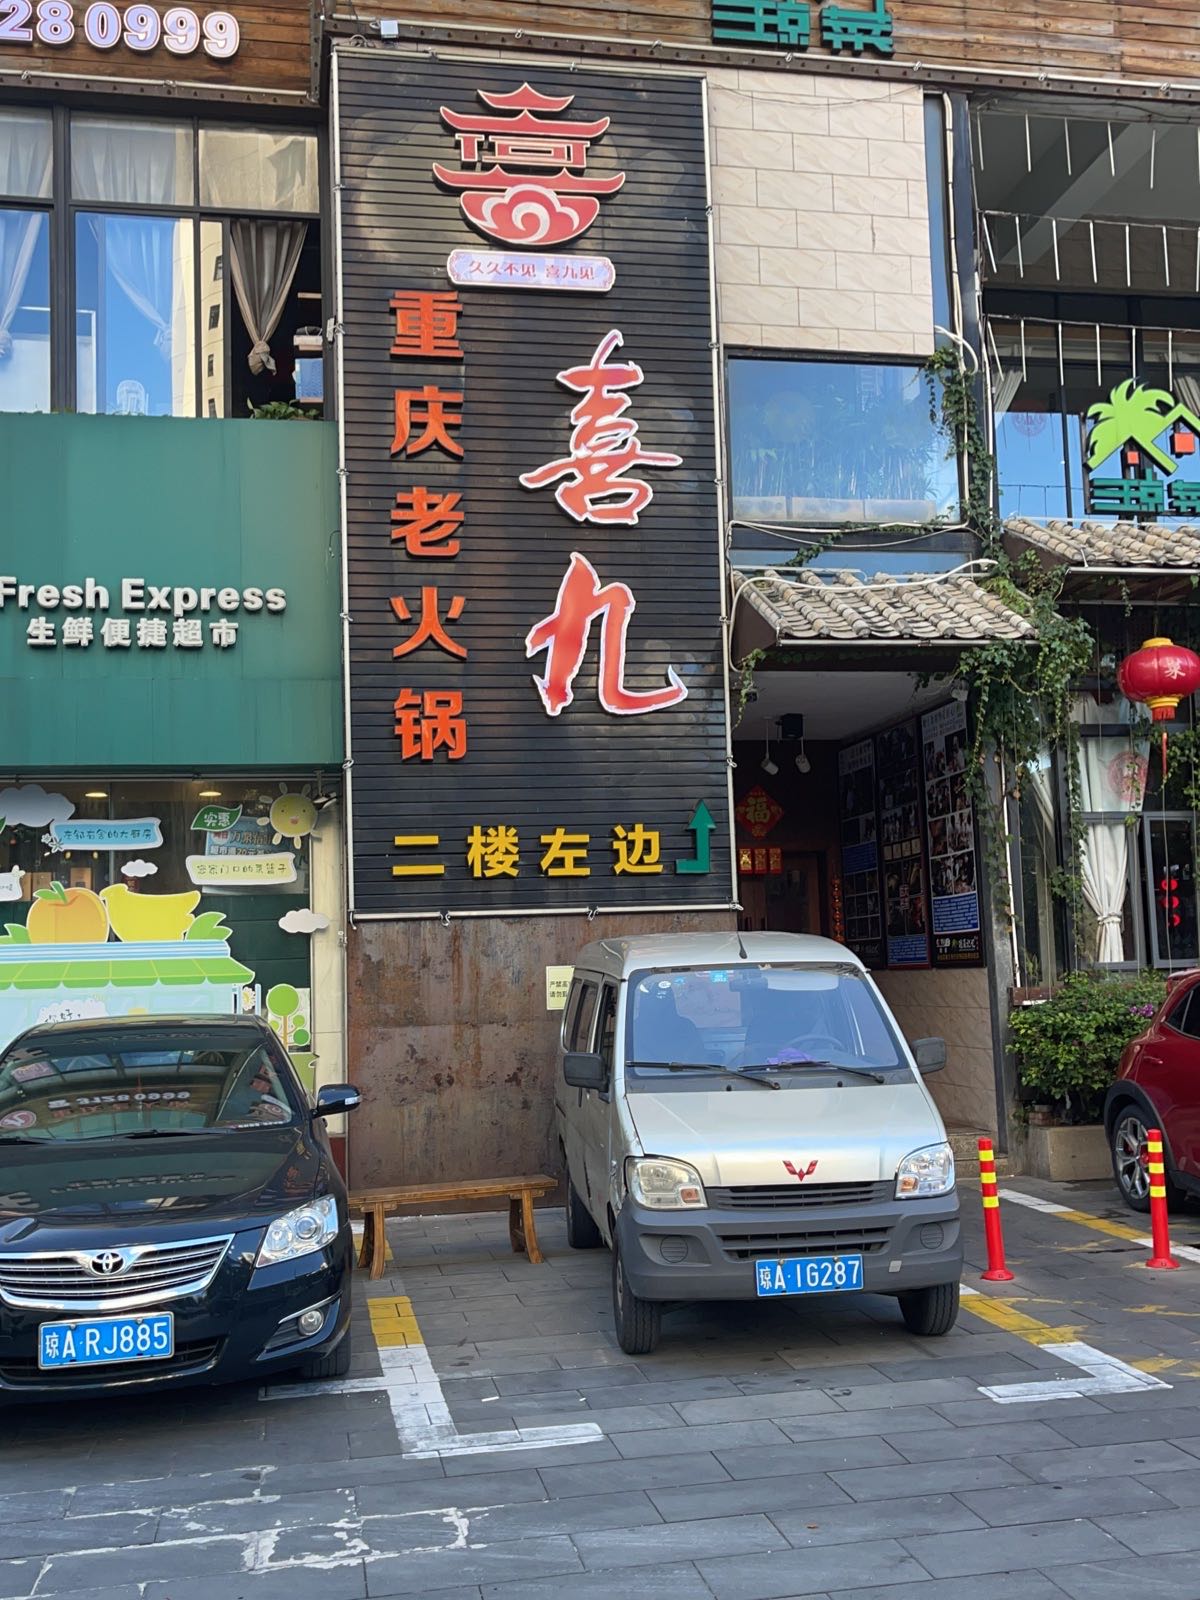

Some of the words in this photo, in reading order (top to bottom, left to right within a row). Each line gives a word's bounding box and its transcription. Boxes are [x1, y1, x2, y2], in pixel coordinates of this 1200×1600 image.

[85, 3, 240, 58] 0999
[469, 260, 537, 277] 久久不见
[545, 264, 595, 280] 喜九见
[389, 290, 468, 760] 重庆老火锅
[518, 329, 689, 717] 喜九
[0, 576, 110, 610] Fresh
[121, 577, 287, 617] Express
[26, 616, 239, 648] 生鲜便捷超市
[203, 811, 231, 827] 实惠
[391, 823, 664, 878] 二楼左边
[759, 1259, 861, 1291] 琼A·1G287
[45, 1321, 168, 1359] 琼A·RJ885
